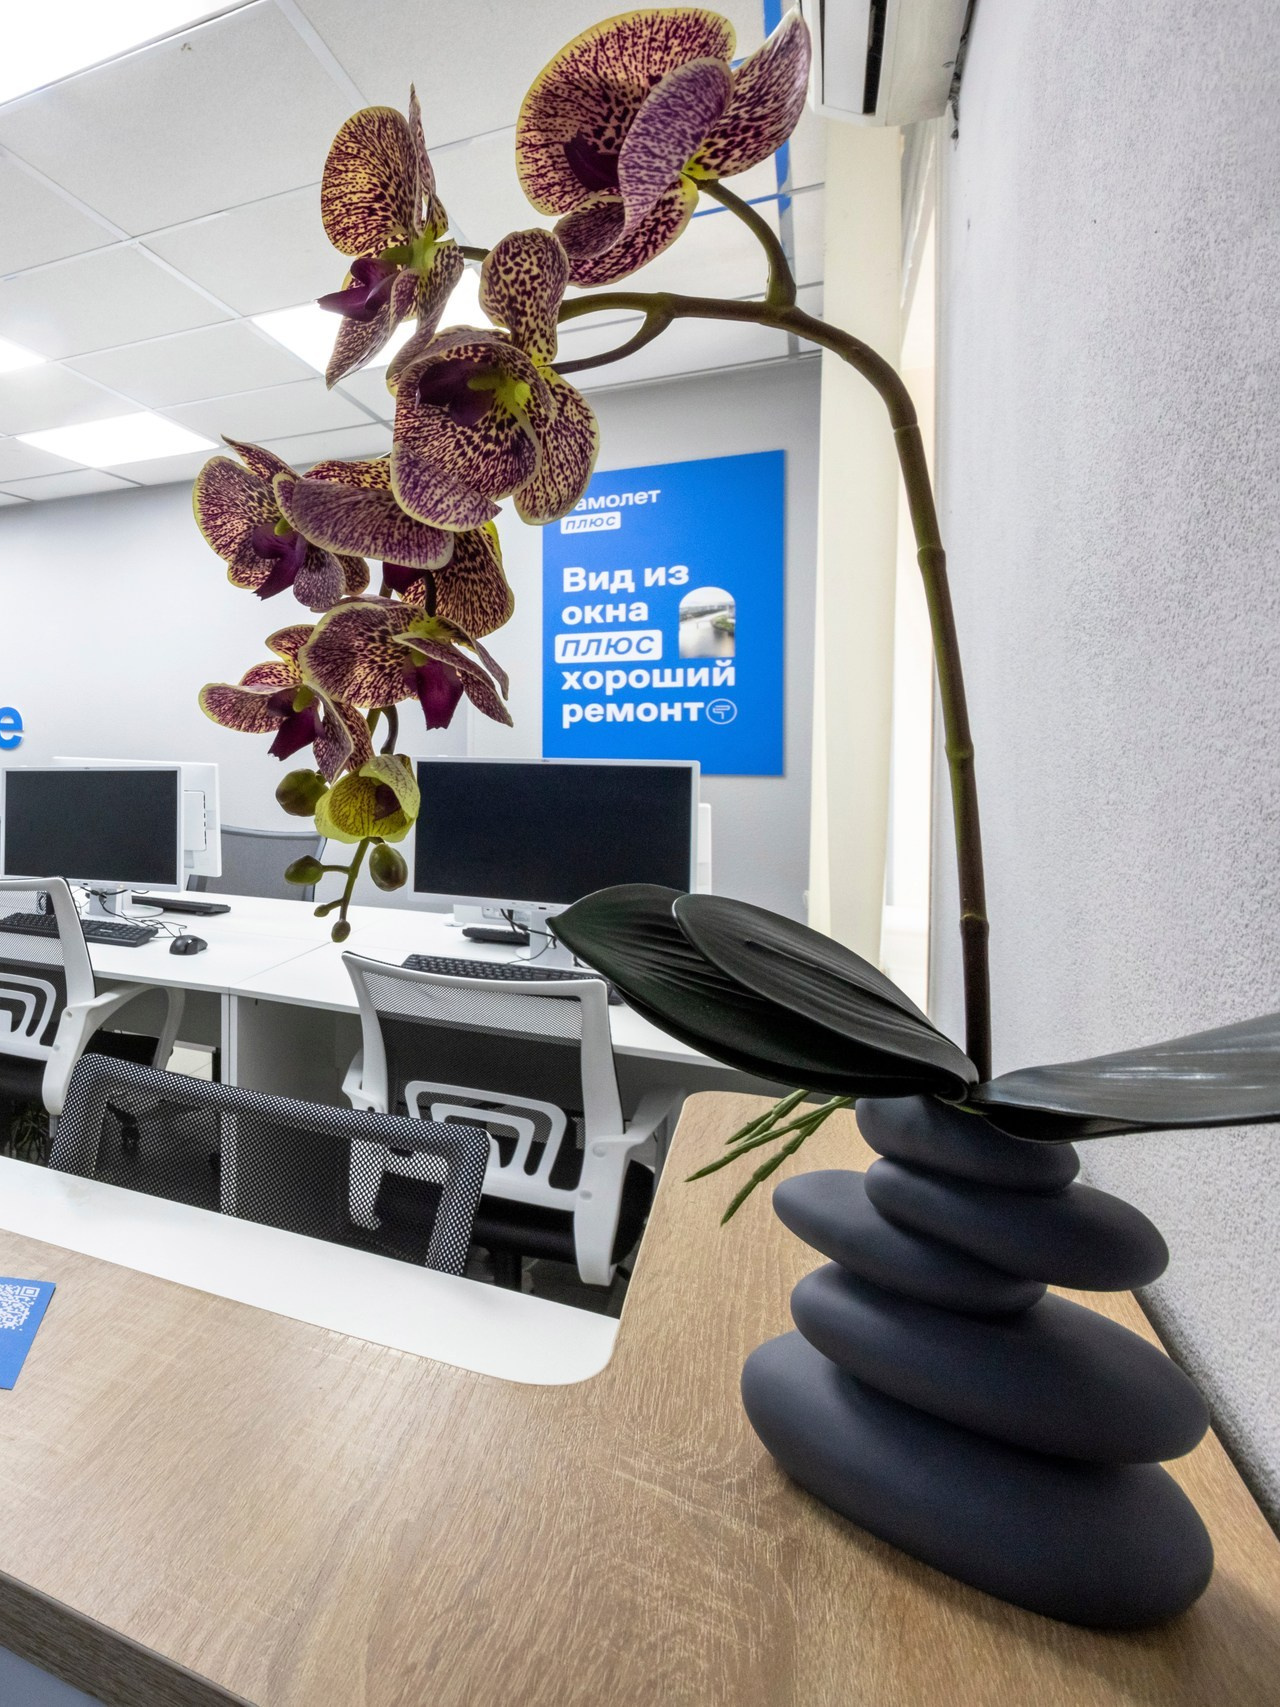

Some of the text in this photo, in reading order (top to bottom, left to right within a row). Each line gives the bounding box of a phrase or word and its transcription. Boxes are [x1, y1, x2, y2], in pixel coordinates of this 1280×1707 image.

[575, 489, 661, 511] амолет
[565, 516, 616, 531] плюс
[562, 564, 690, 594] Вид из
[561, 601, 649, 625] окна
[561, 635, 656, 657] плюс
[560, 659, 736, 696] хороший
[562, 702, 704, 729] ремонт
